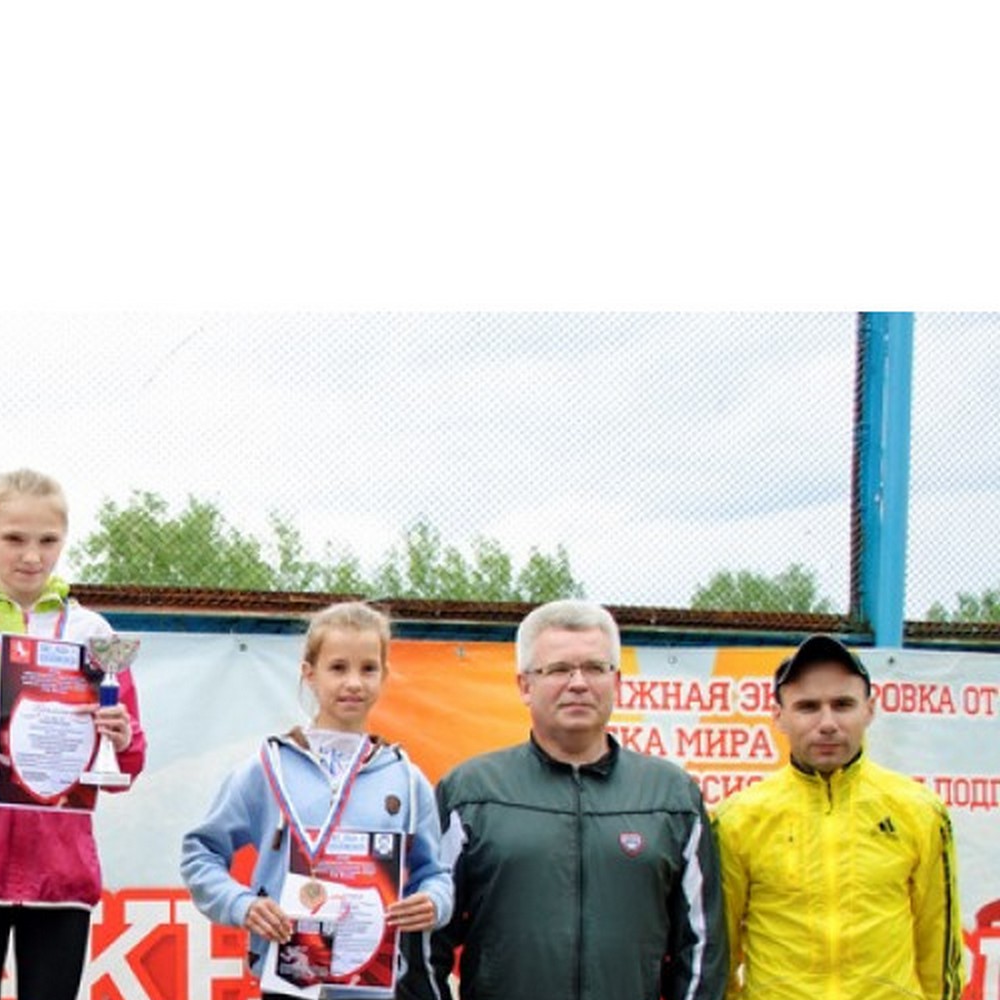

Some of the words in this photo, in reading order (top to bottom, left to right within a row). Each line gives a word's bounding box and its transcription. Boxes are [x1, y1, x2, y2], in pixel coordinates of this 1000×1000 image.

[963, 686, 998, 715] ОТ
[604, 726, 668, 757] КА
[675, 728, 774, 758] МИРА
